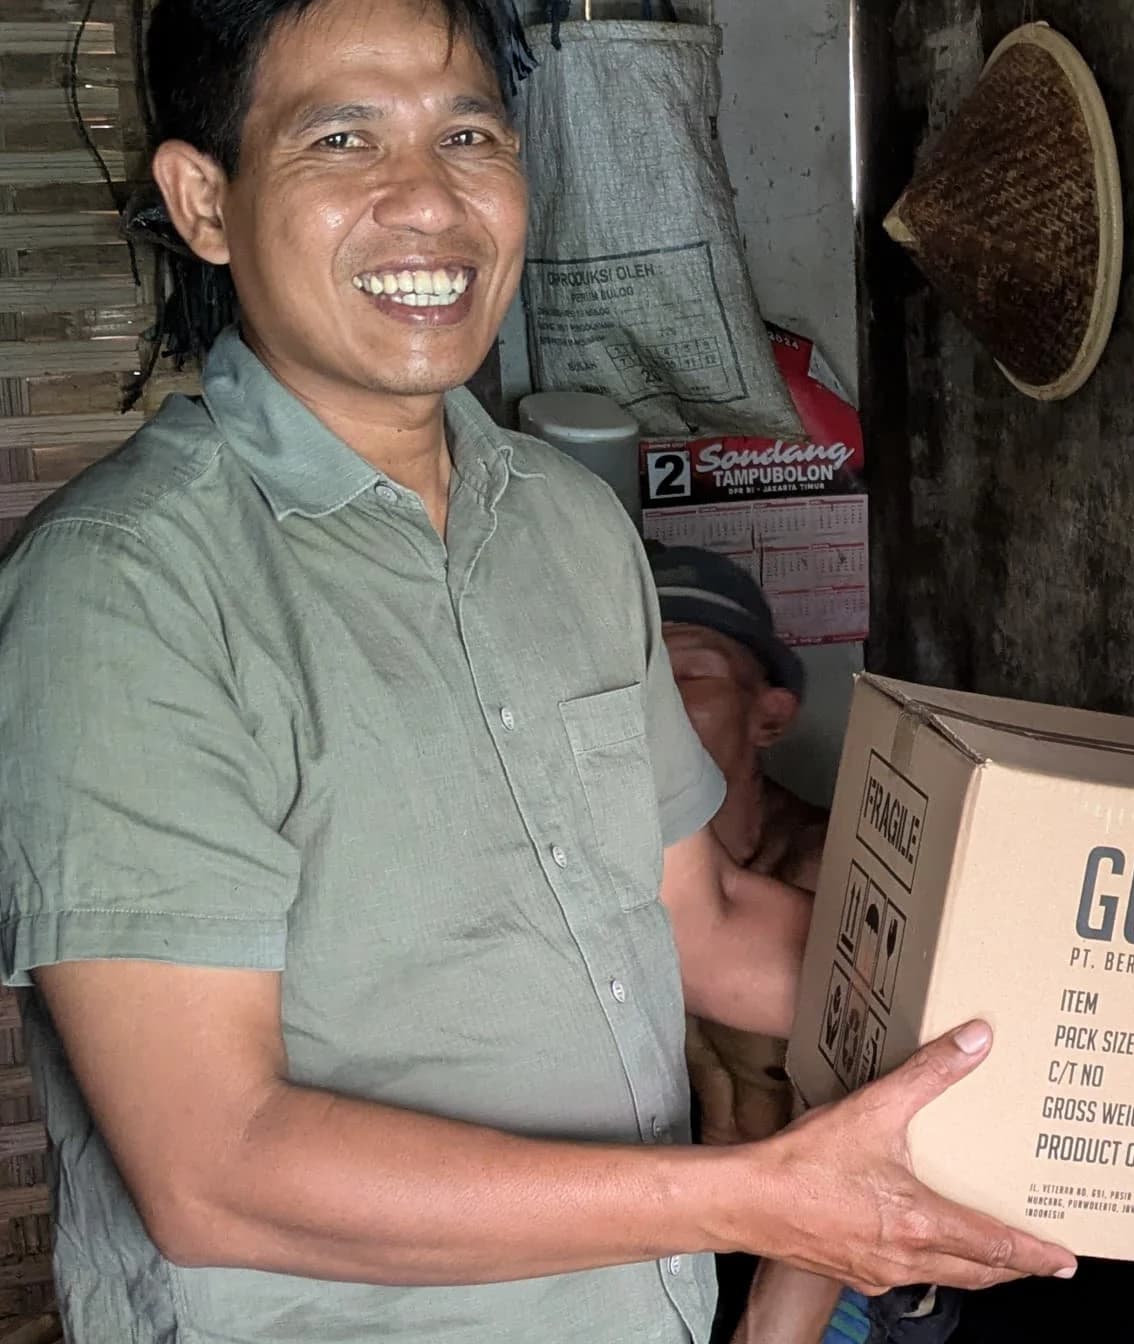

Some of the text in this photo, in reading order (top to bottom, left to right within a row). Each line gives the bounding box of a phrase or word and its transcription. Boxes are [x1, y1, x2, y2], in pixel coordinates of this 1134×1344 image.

[616, 263, 655, 281] OLEH
[654, 439, 856, 496] 2 Sondang
[712, 465, 834, 488] TAMPUBOLON
[728, 487, 744, 495] DPR
[763, 484, 798, 493] JAKARTA
[799, 483, 825, 491] TIMUR
[863, 776, 921, 864] FRAGILE
[1069, 947, 1095, 970] PT.
[1060, 989, 1099, 1015] ITEM
[1054, 1025, 1097, 1052] PACK
[1047, 1060, 1079, 1086] C/T
[1080, 1064, 1105, 1087] NO
[1041, 1096, 1098, 1123] GROSS
[1035, 1133, 1123, 1167] PRODUCT
[1026, 1195, 1065, 1209] MUNCANG,
[1067, 1199, 1119, 1213] PURWOKERTO,
[1042, 1184, 1074, 1196] VETERAN
[1076, 1186, 1089, 1198] NO.
[1110, 1190, 1133, 1201] PASIR
[1025, 1208, 1065, 1220] INDONESIA
